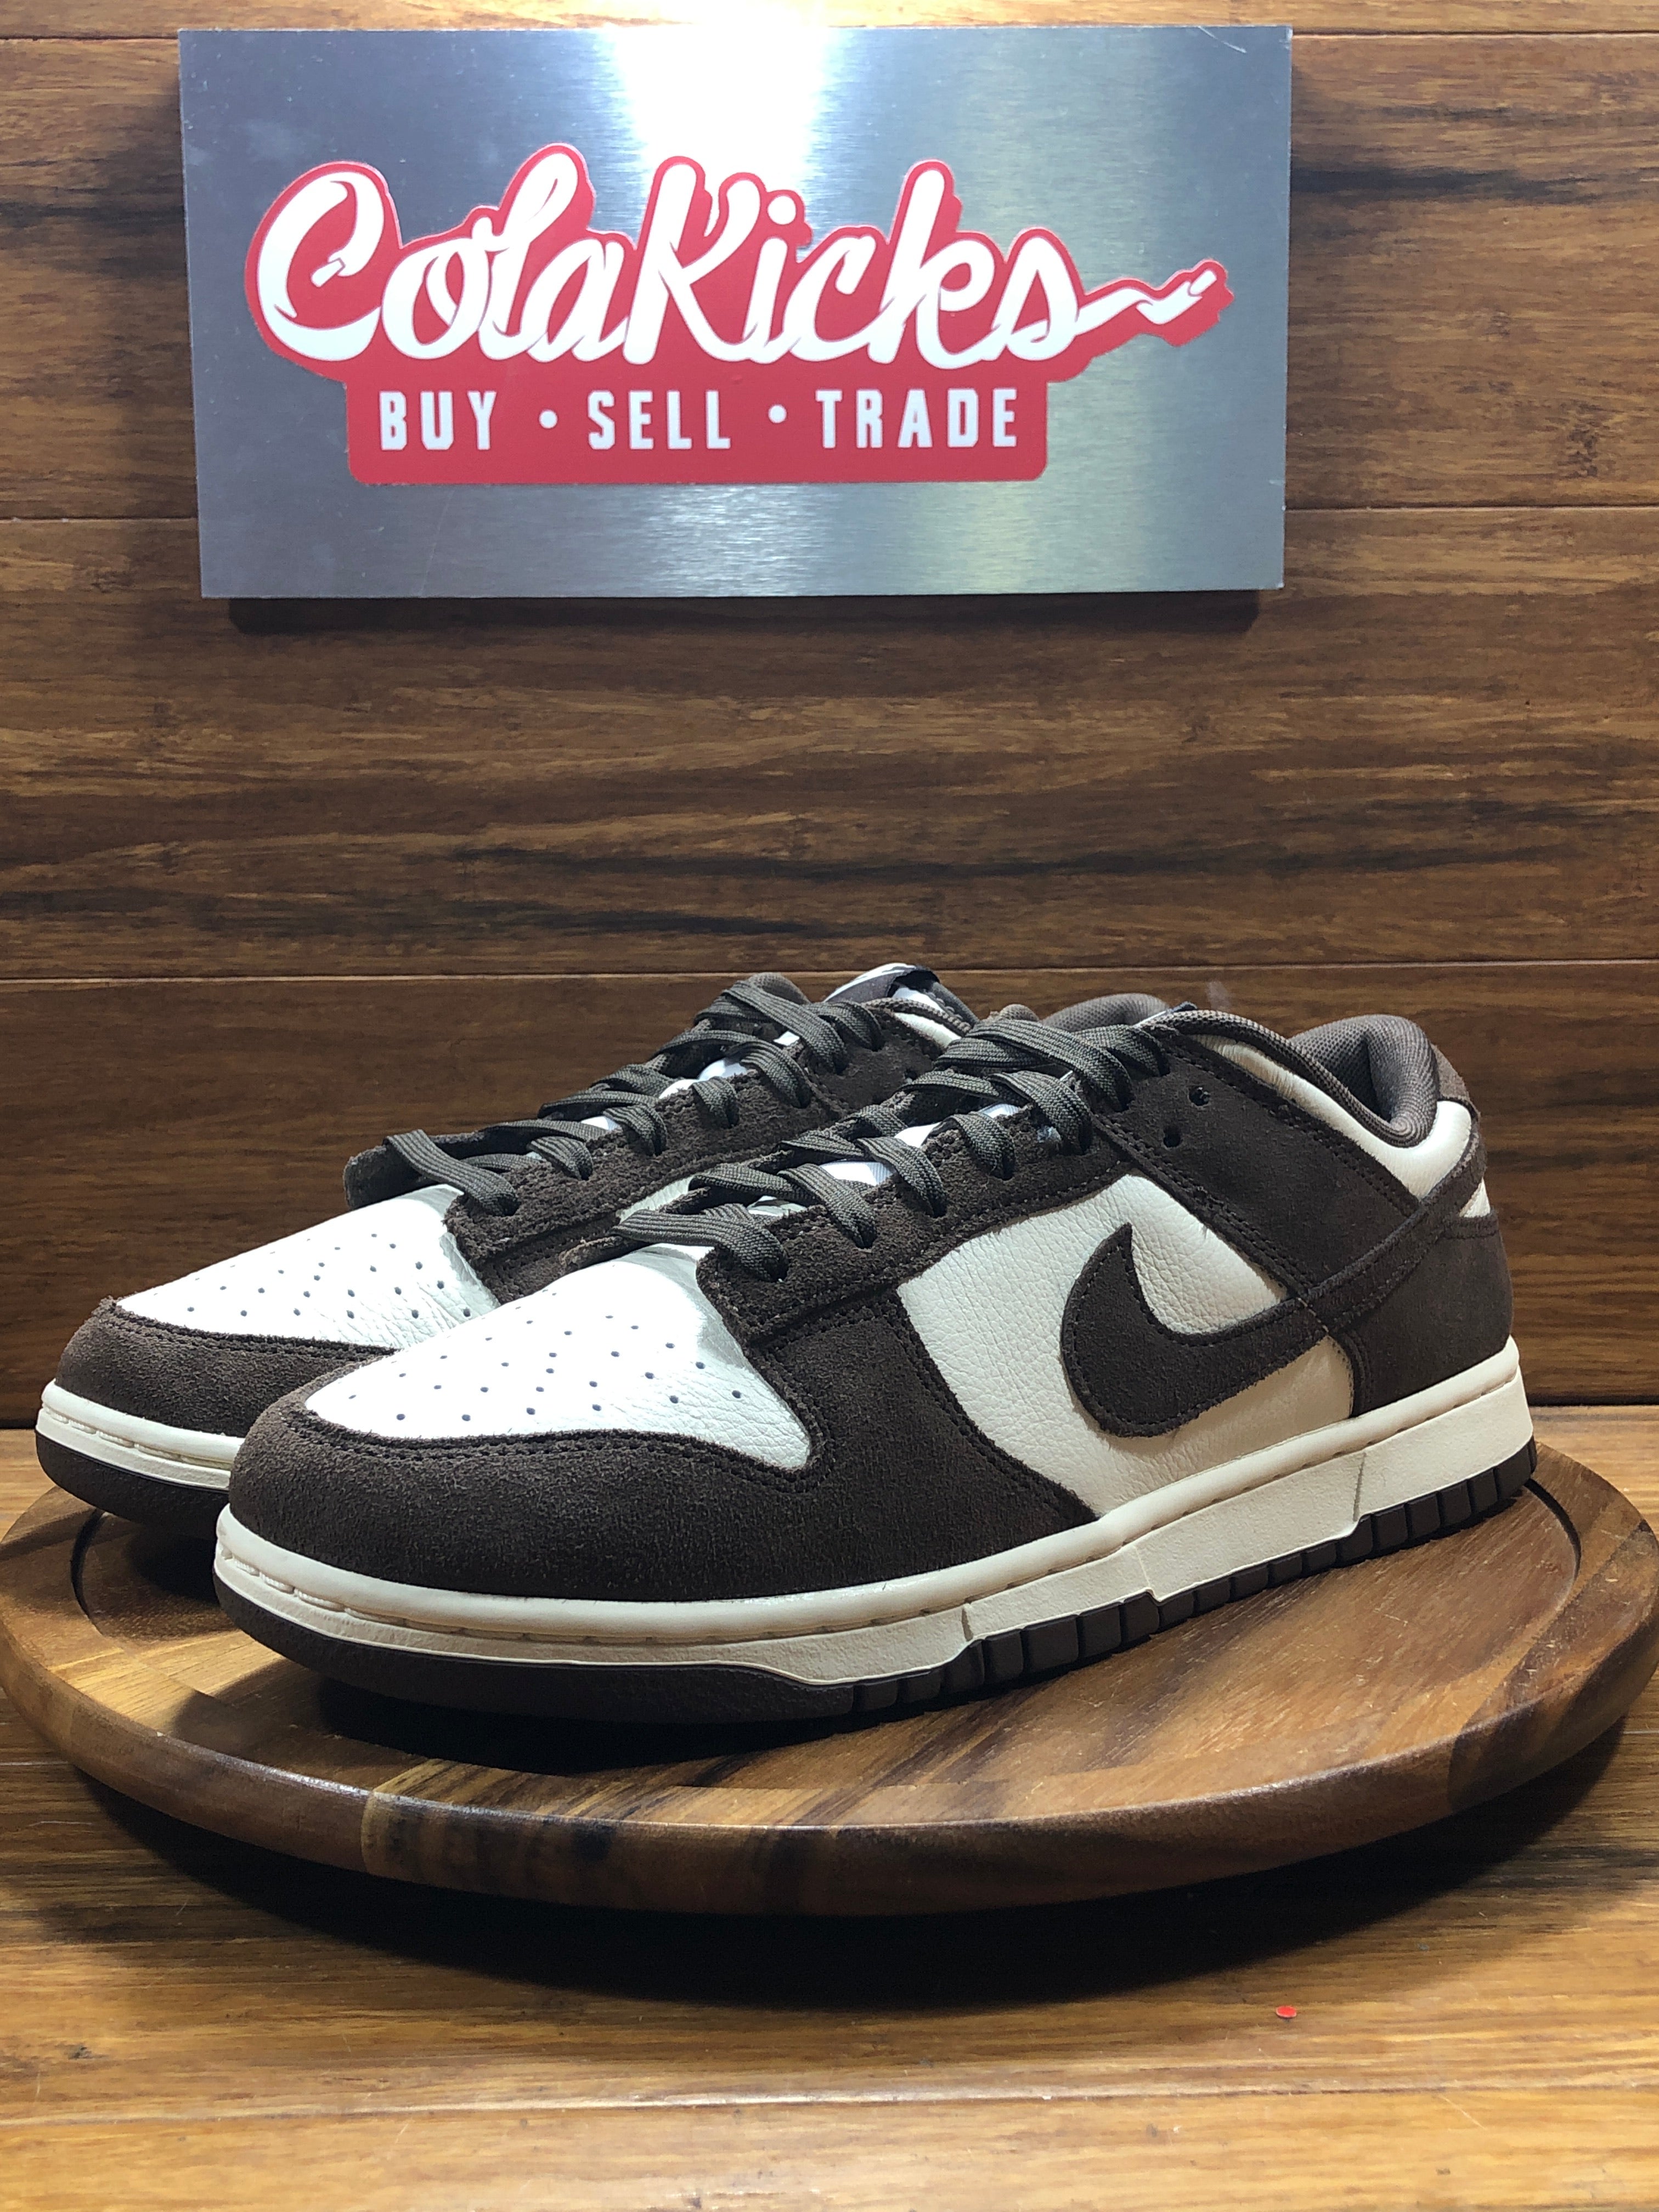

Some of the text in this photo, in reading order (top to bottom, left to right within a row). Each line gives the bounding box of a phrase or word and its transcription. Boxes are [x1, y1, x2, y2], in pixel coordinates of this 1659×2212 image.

[257, 148, 1217, 369] ColaKicks
[380, 388, 1017, 450] BUY SELL TRADE
